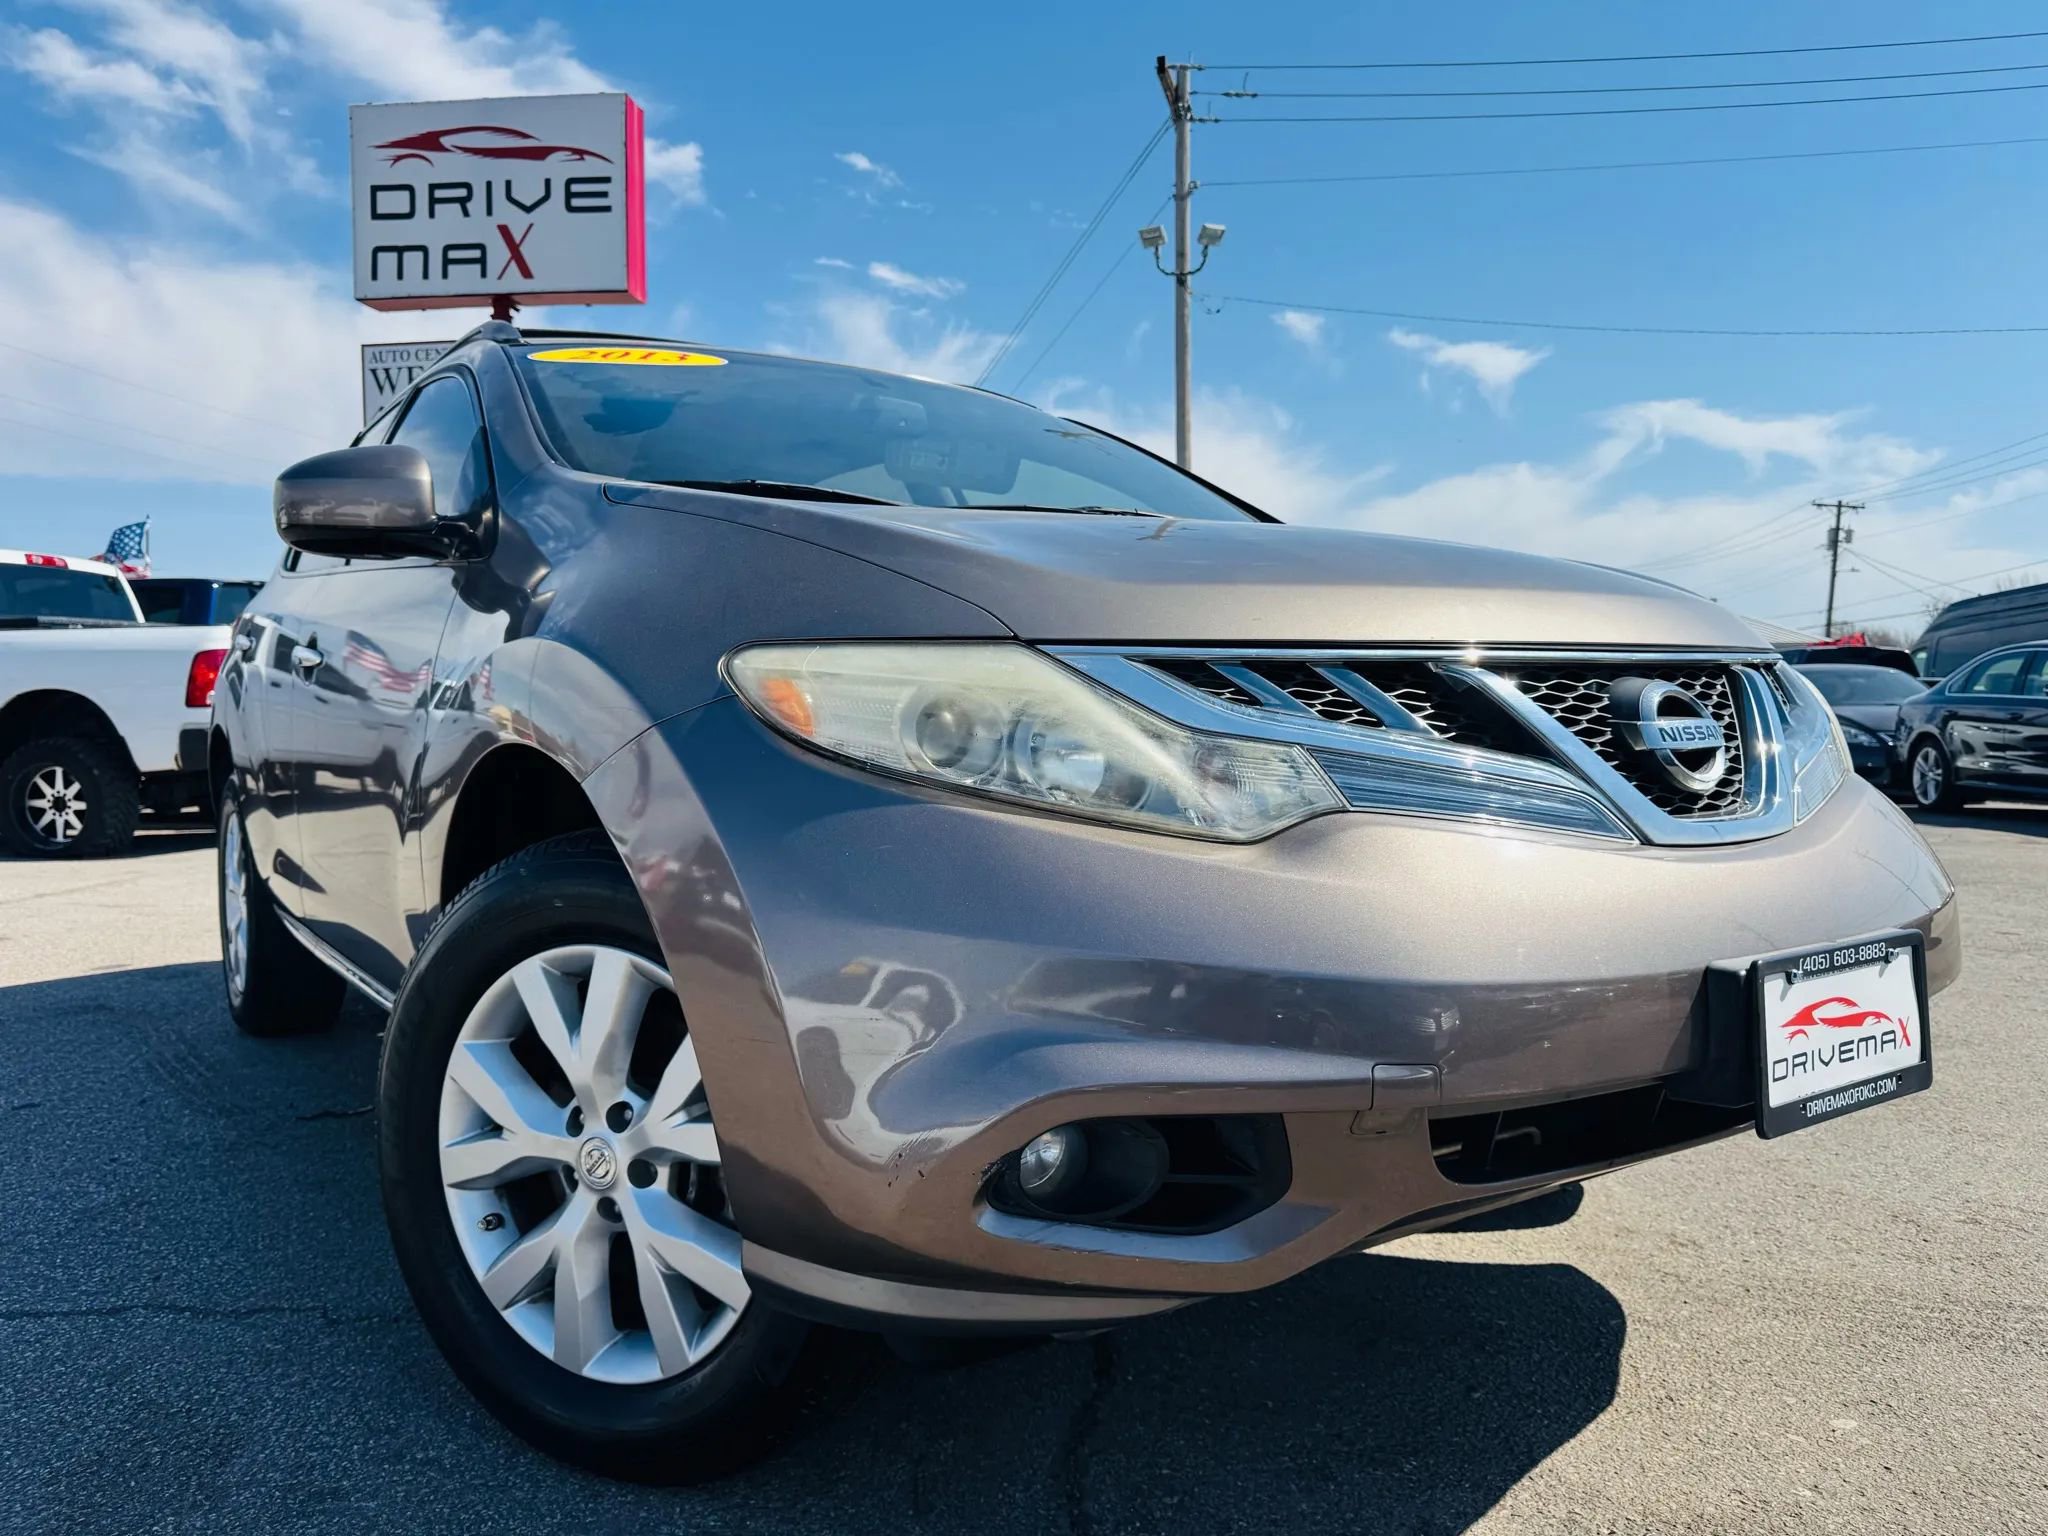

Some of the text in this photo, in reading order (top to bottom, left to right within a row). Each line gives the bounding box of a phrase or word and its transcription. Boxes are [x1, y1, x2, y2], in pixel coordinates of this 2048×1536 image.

[370, 176, 612, 220] DRIVE
[371, 223, 534, 280] MAX
[369, 349, 411, 364] AUTO
[567, 350, 691, 362] 2013
[1658, 724, 1721, 743] NISSAN
[1799, 953, 1830, 972] (405)
[1833, 942, 1886, 966] 603-8883
[1772, 1016, 1911, 1083] DRIVEMAX
[1806, 1076, 1897, 1118] DRIVEMAXOFOKC.COM
